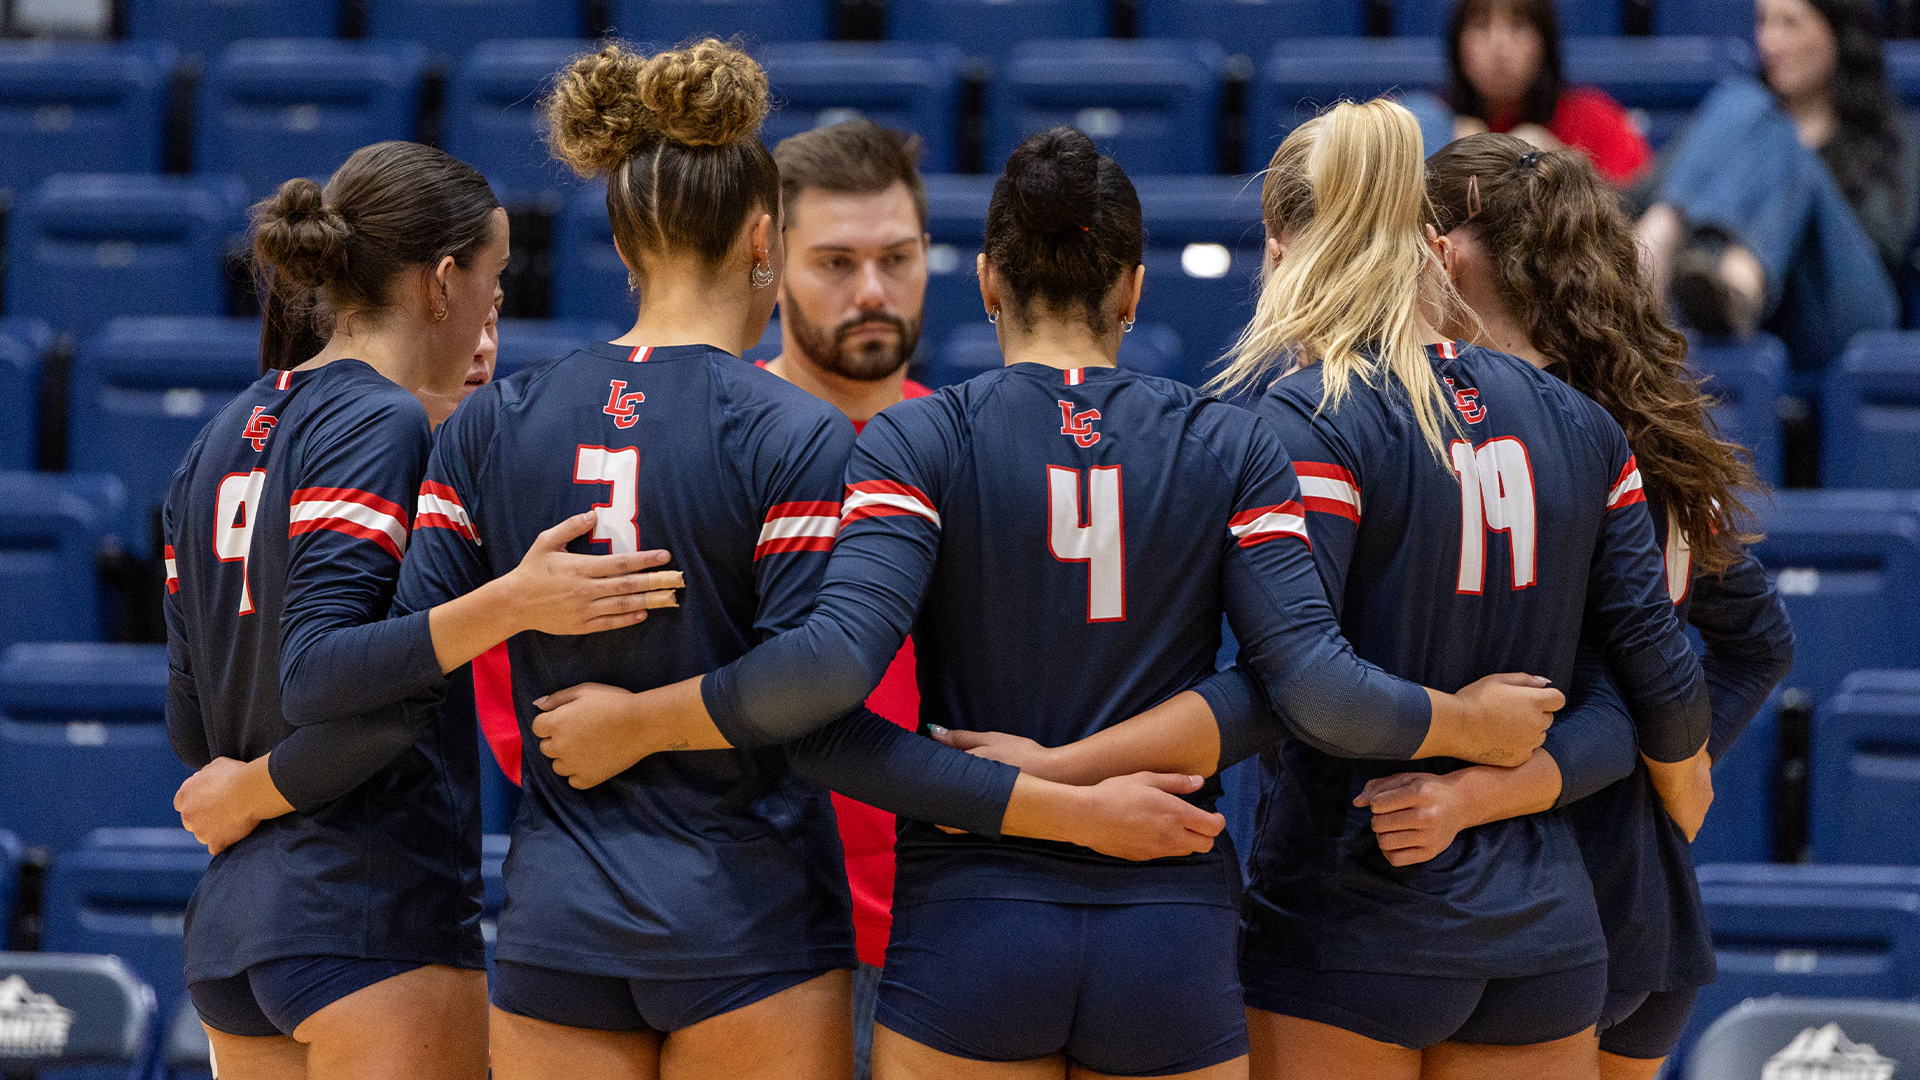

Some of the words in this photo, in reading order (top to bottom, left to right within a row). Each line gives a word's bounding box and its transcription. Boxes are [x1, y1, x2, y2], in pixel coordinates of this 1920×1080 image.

[242, 405, 278, 452] LC
[603, 379, 645, 429] LC
[1058, 400, 1101, 448] LC
[212, 467, 267, 616] 9
[573, 444, 641, 558] 3
[1046, 464, 1126, 623] 4
[1449, 435, 1537, 596] 19
